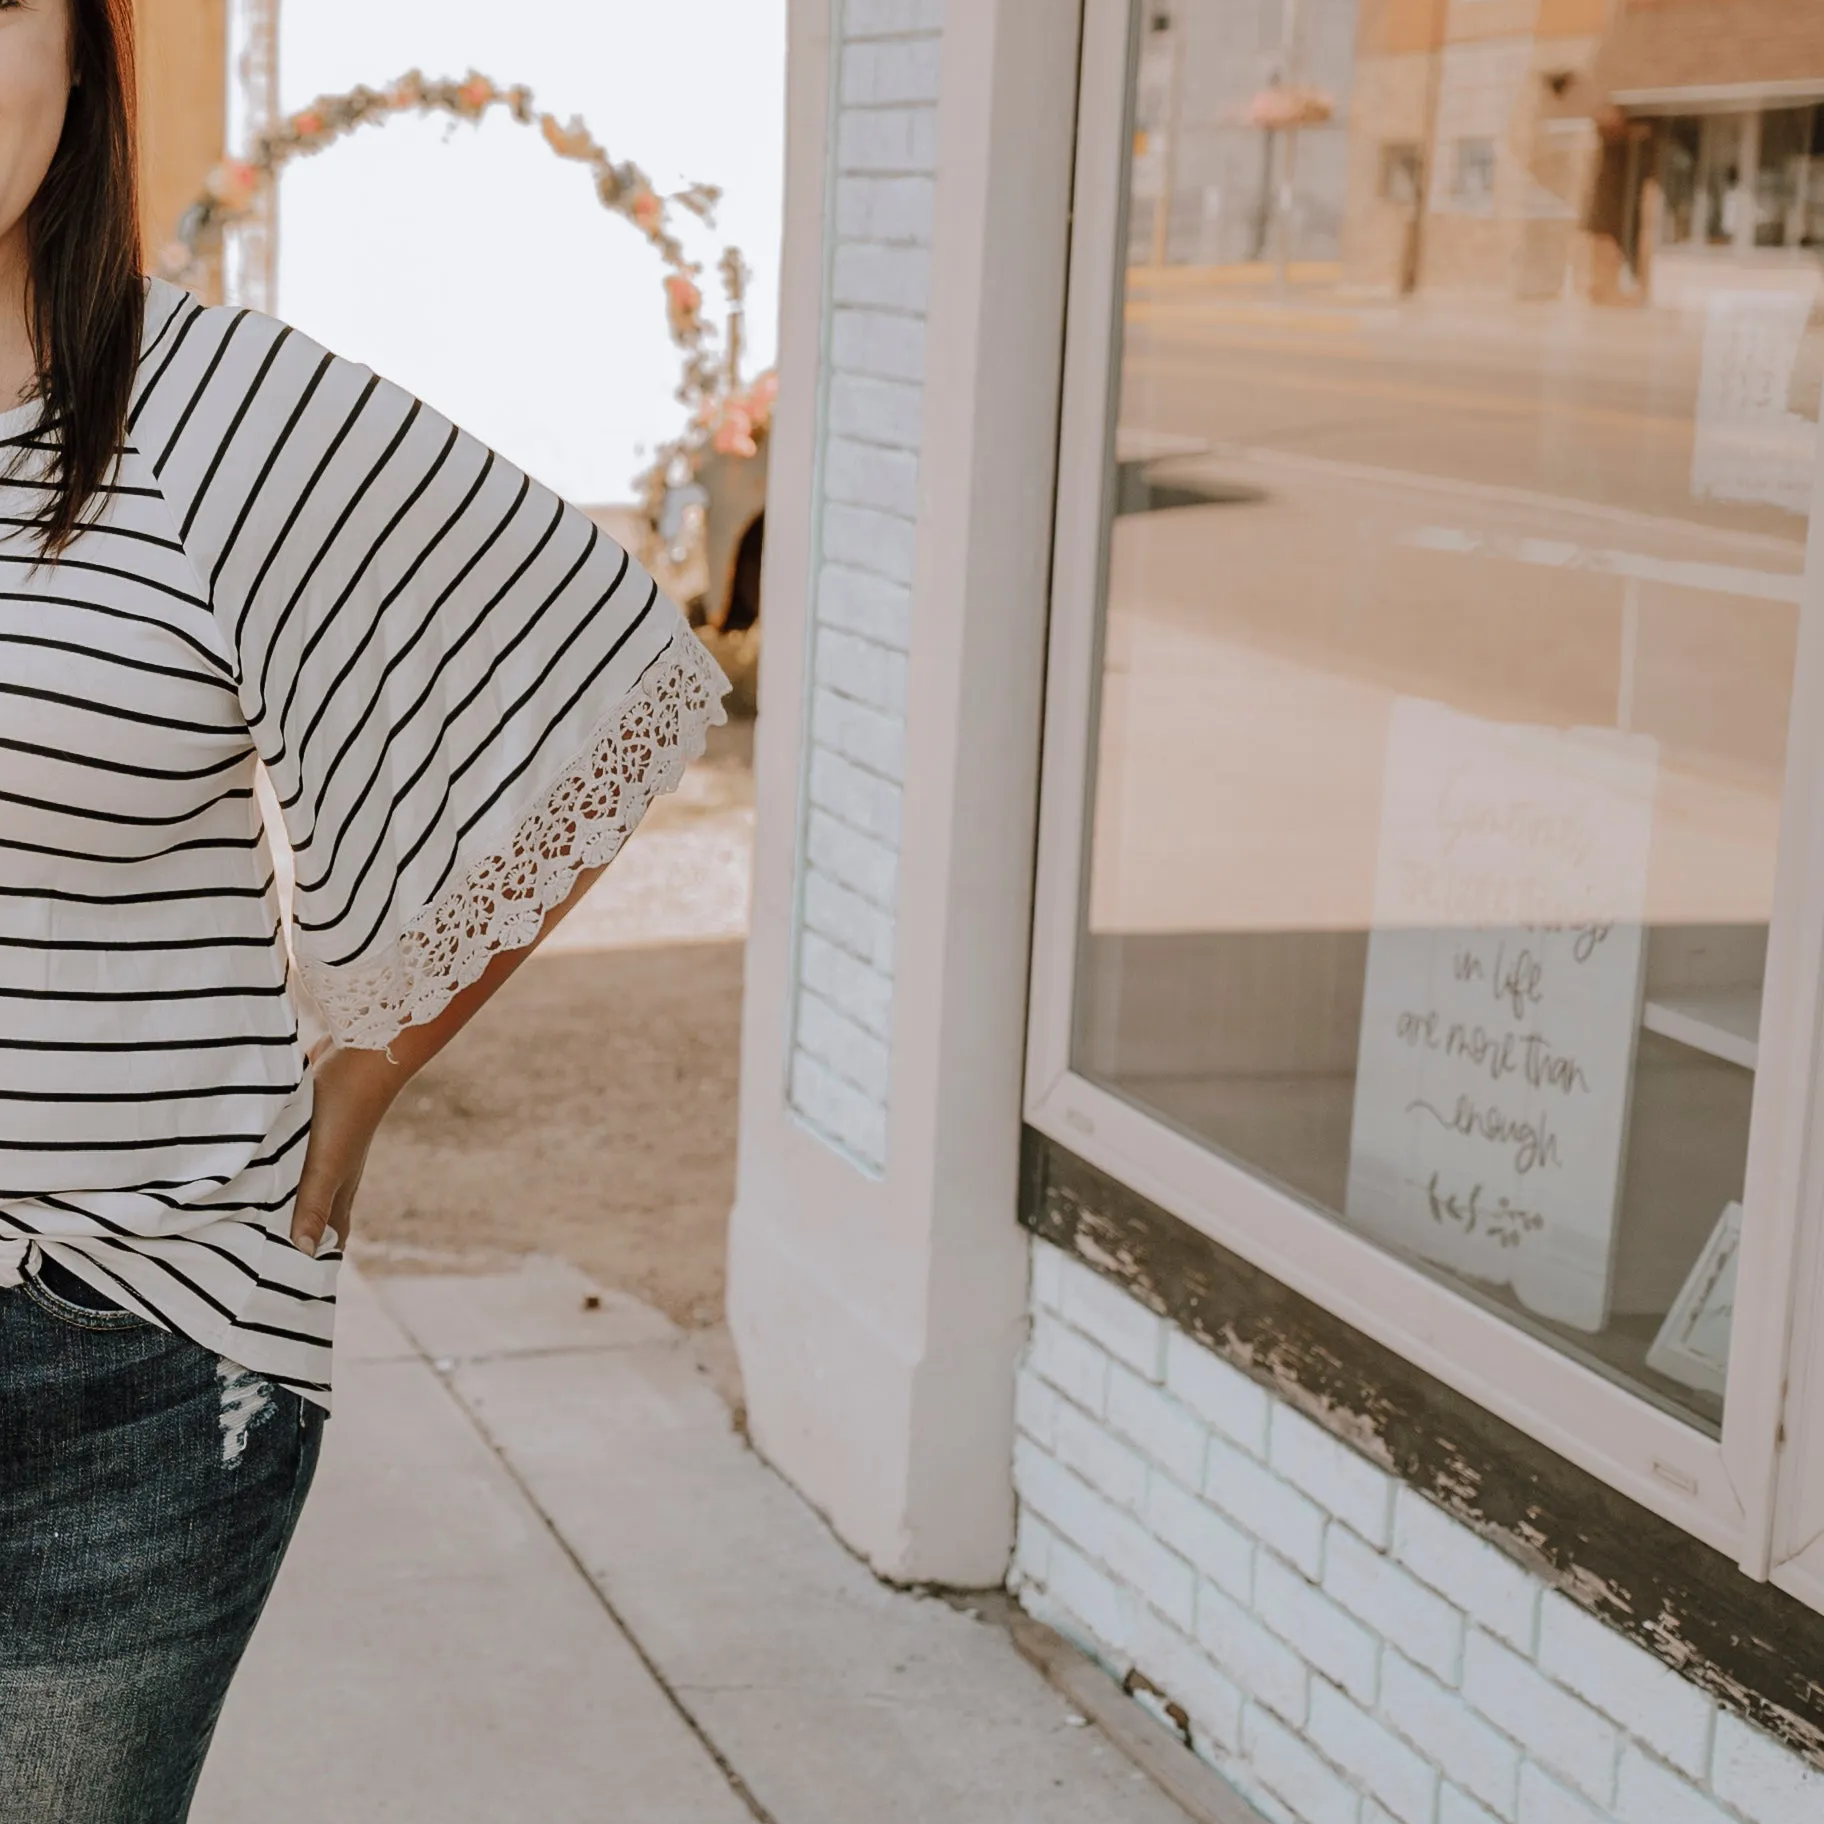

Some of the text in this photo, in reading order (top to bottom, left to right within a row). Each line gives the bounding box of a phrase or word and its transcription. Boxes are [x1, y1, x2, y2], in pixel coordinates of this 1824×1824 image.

[1452, 939, 1544, 1021] in life
[1395, 1010, 1592, 1095] are more than
[1404, 1092, 1563, 1175] enough
